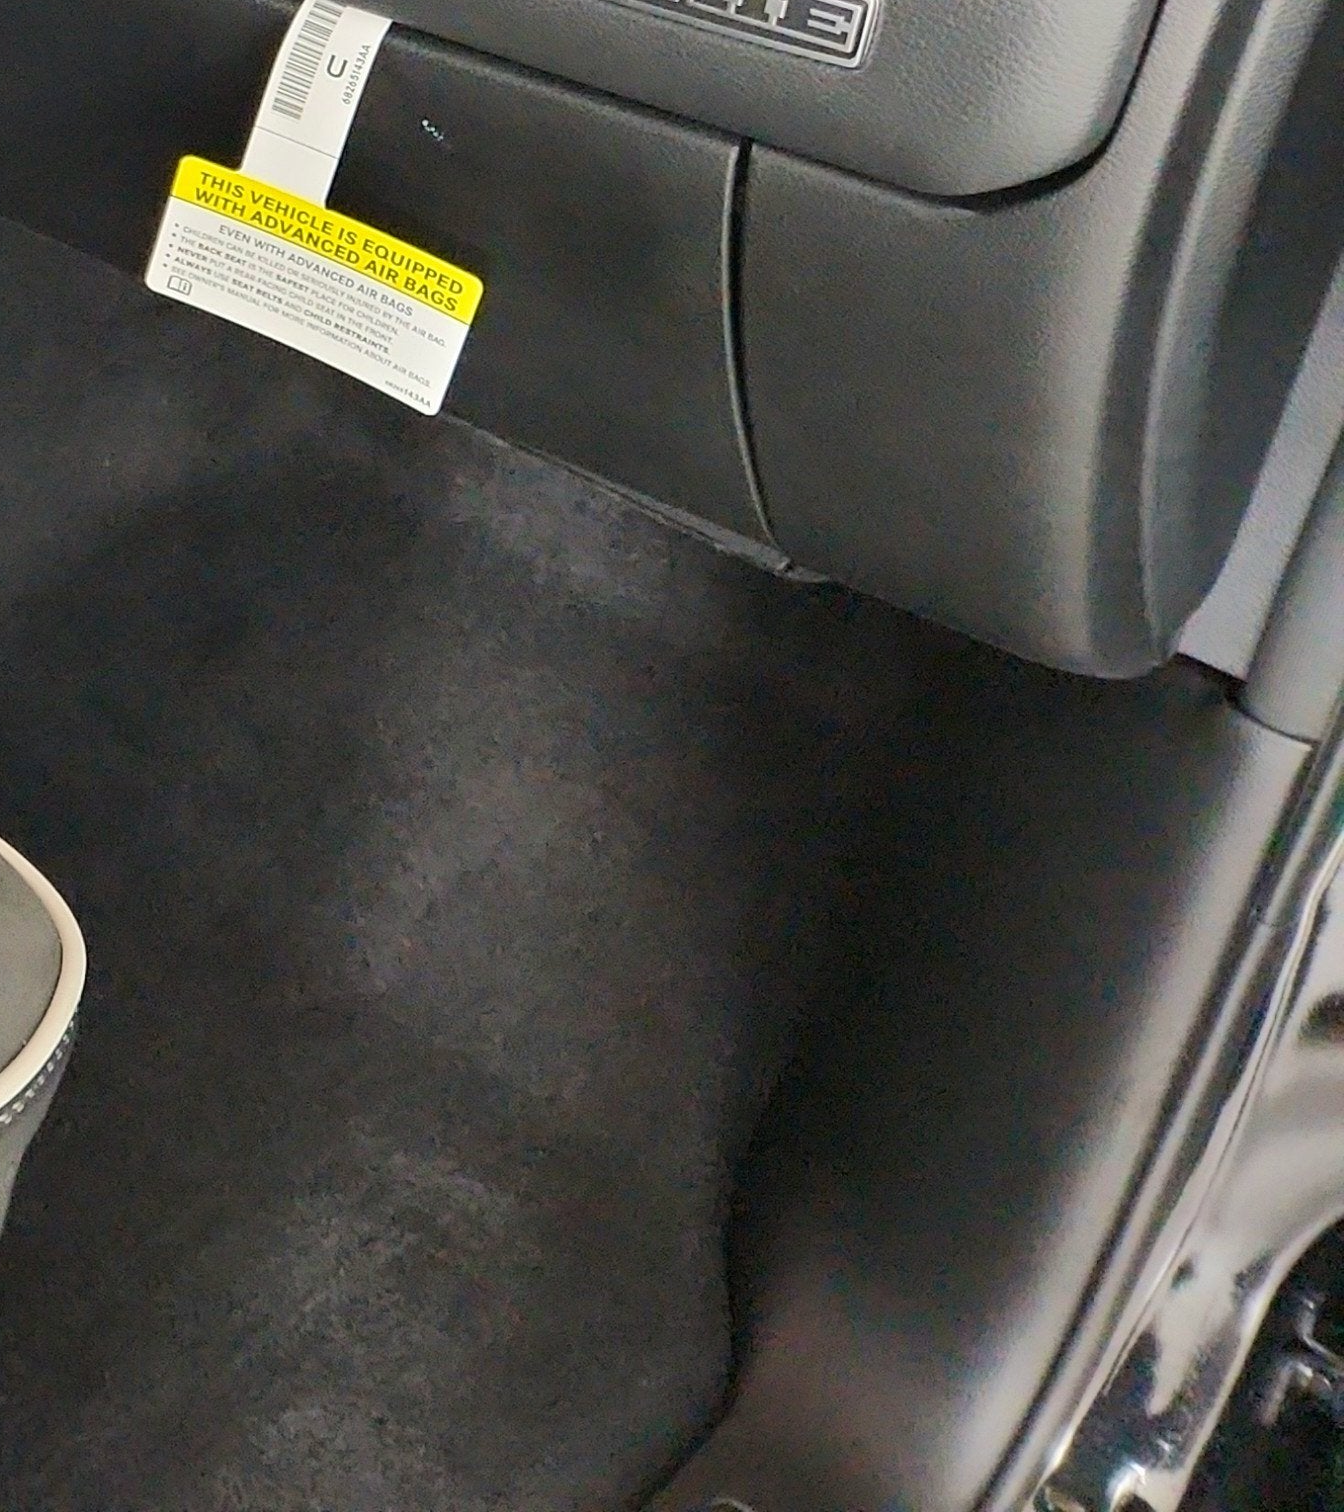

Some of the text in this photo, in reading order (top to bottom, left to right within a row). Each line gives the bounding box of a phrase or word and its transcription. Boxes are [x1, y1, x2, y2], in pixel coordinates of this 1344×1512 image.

[326, 54, 348, 78] U
[342, 44, 371, 105] 68265143AA
[193, 186, 459, 312] WITH ADVANCED AIR BAGS
[197, 242, 222, 257] BACK
[275, 273, 309, 293] SAFEST
[198, 171, 464, 296] THIS VEHICLE IS EQUIPPED
[173, 255, 212, 275] ALWAYS
[302, 308, 332, 327] CHILD
[217, 223, 414, 317] EVEN WITH ADVANCED AIR BAGS
